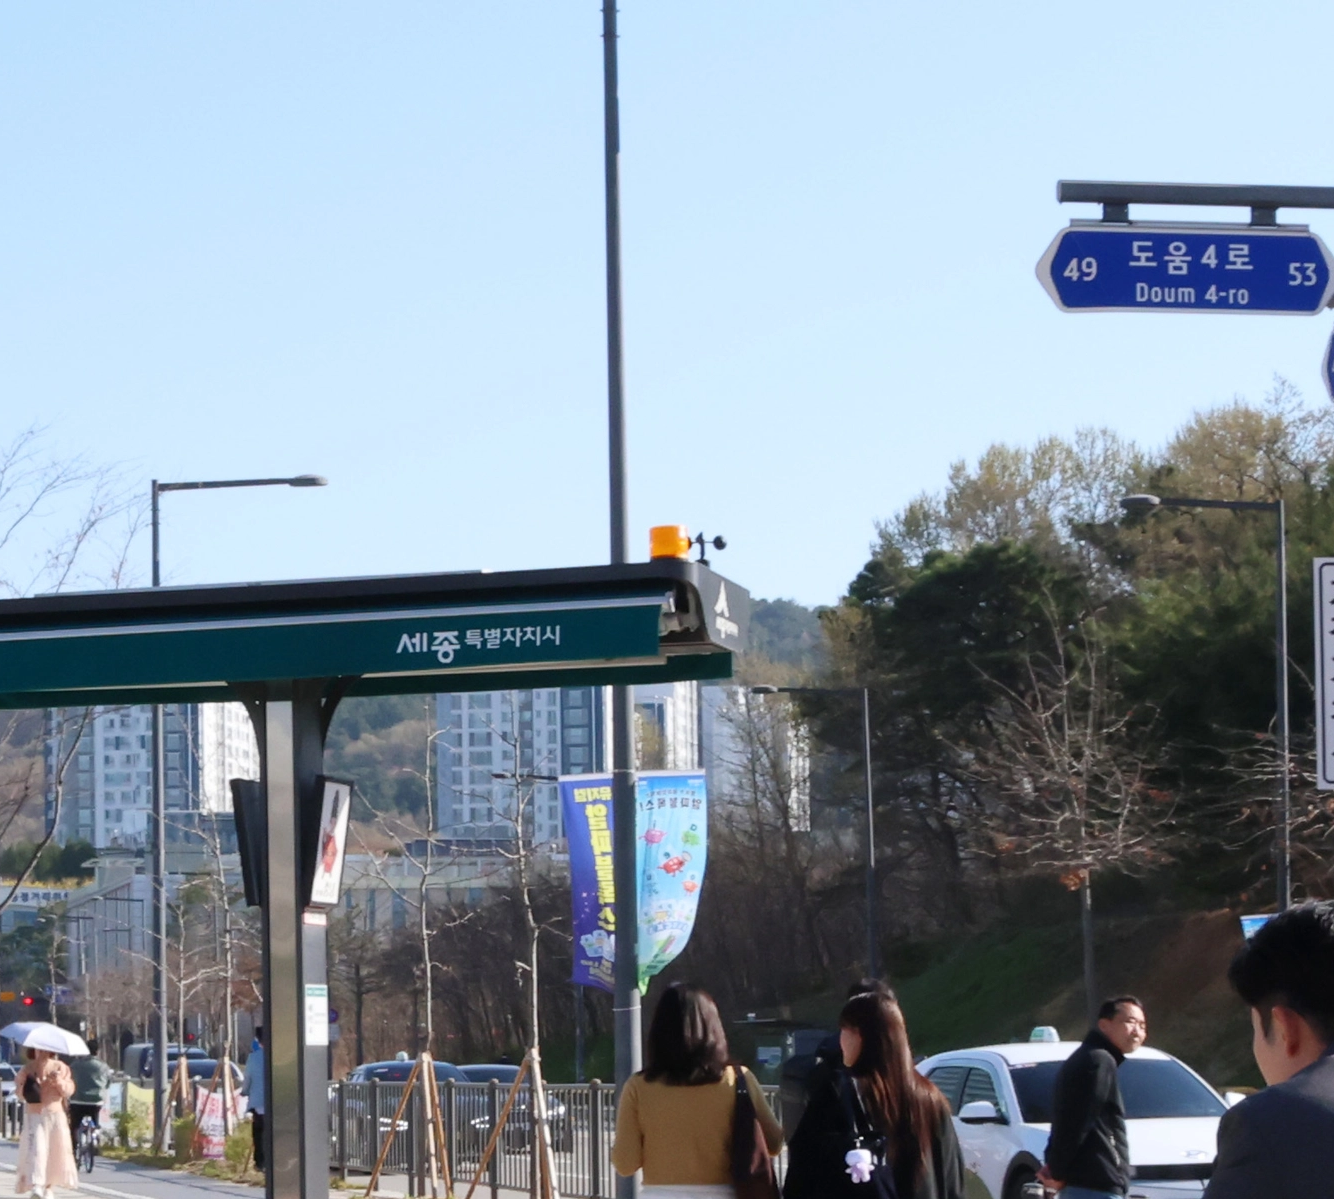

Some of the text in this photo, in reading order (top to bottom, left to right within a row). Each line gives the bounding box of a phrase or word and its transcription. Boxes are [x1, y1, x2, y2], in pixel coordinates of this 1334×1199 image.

[1063, 256, 1098, 282] 49
[1129, 240, 1254, 276] 도움4로
[1288, 262, 1318, 286] 53
[1135, 282, 1250, 305] Doum 4-ro
